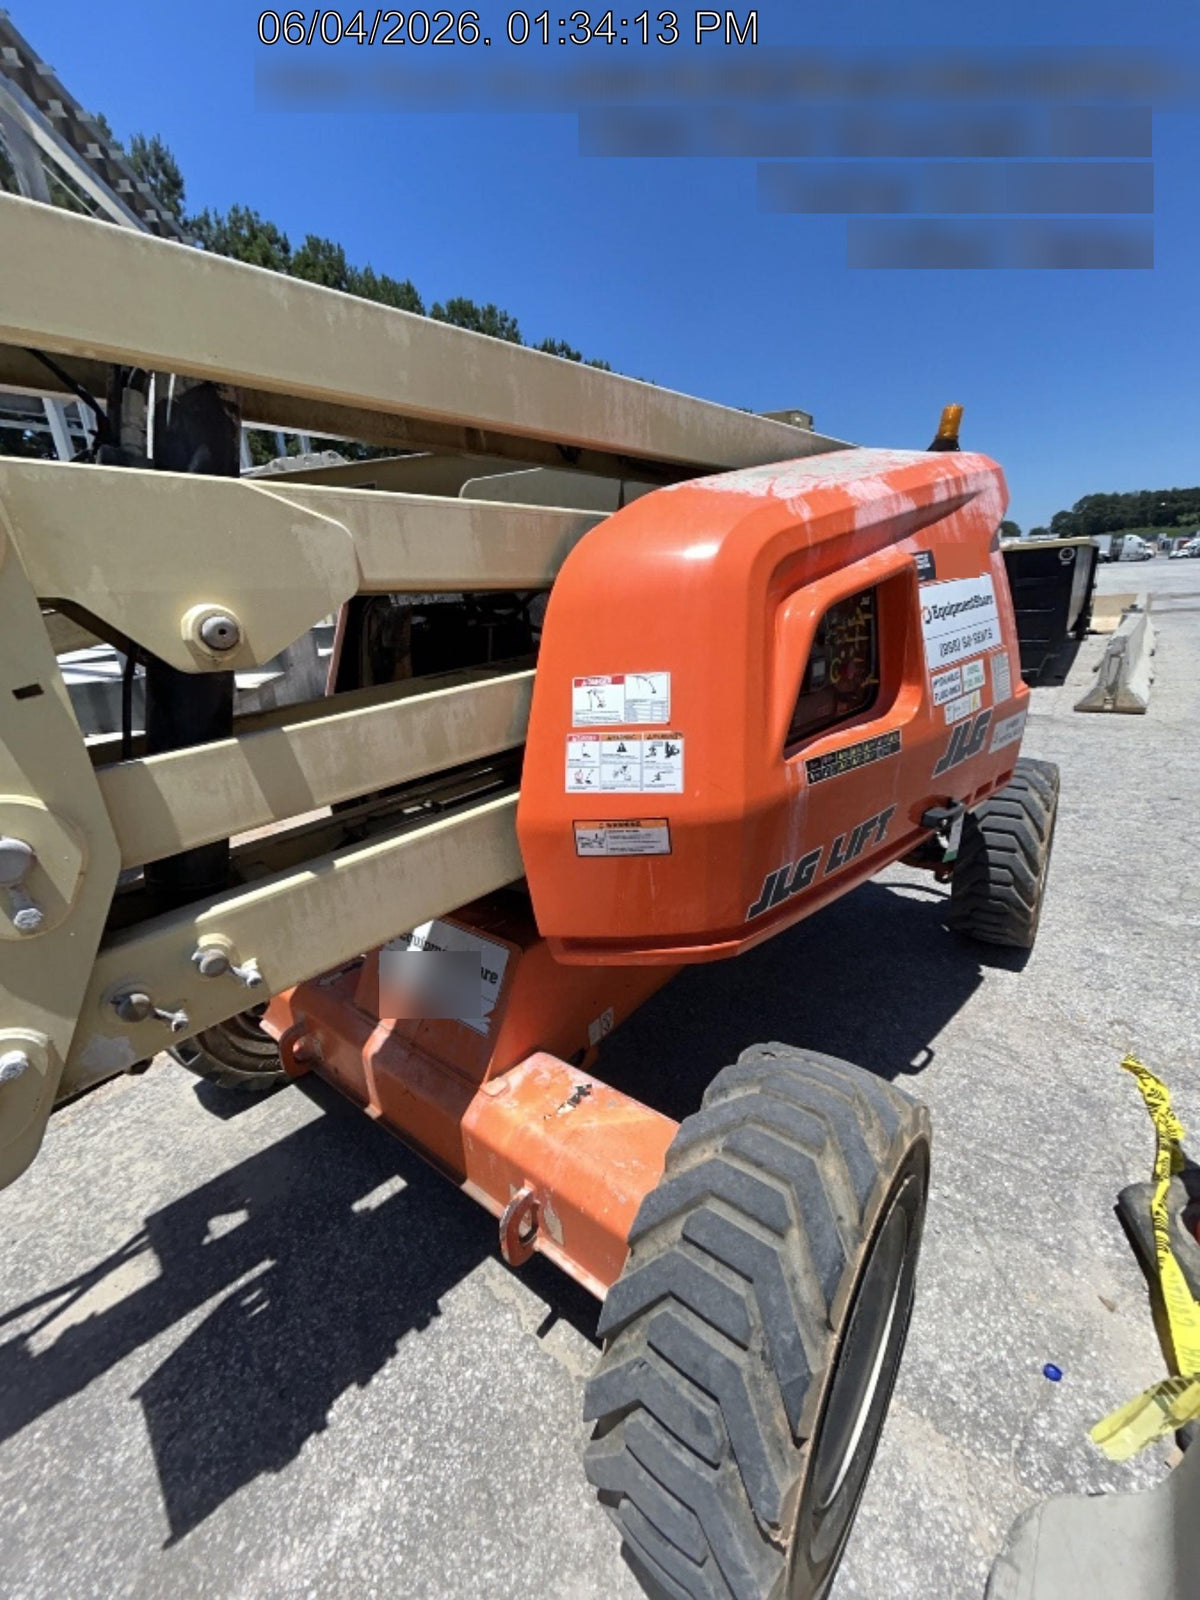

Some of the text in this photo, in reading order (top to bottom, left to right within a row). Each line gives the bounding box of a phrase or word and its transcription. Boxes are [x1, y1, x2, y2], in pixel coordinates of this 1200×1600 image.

[932, 707, 993, 779] JLG
[745, 803, 897, 922] JLG LIFT
